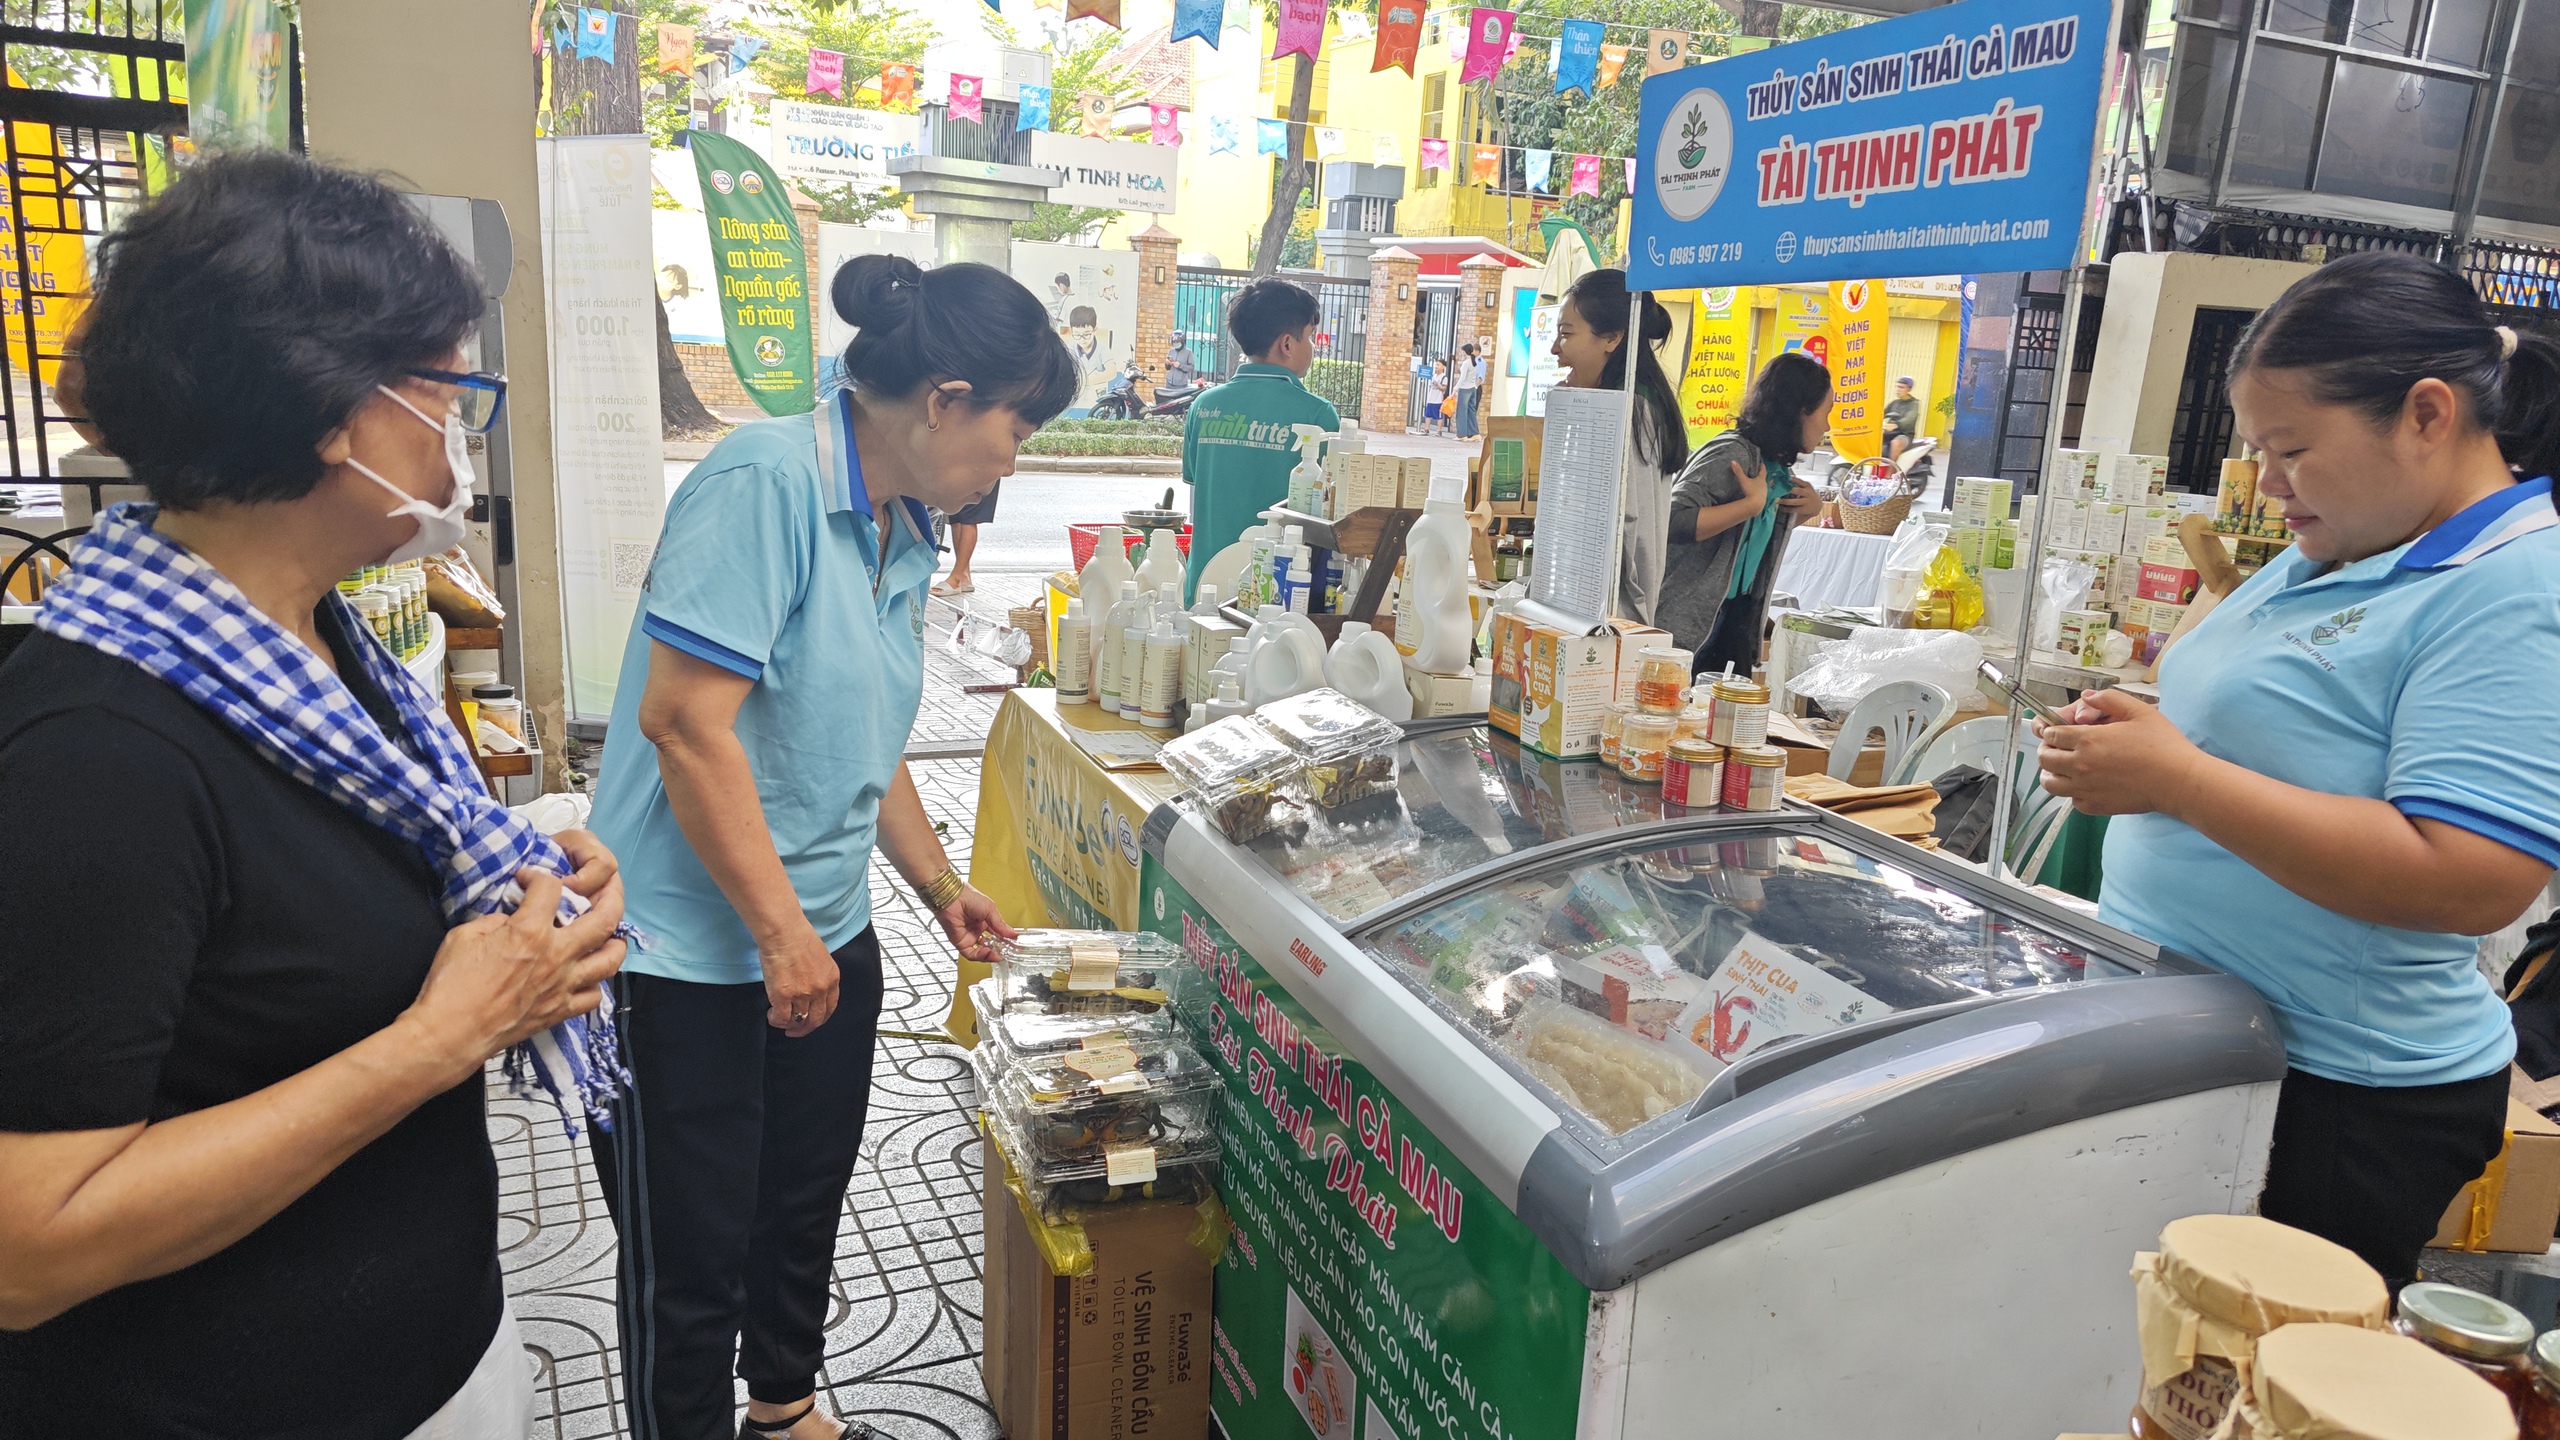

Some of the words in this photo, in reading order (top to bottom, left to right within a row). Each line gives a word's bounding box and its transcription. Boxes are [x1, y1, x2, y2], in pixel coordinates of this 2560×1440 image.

[1288, 7, 1321, 25] bạch
[1567, 26, 1590, 42] Thân
[1574, 40, 1598, 56] thiện
[1748, 70, 1795, 118] THỦY
[1801, 61, 1841, 107] SẢN
[1849, 57, 1902, 98] SINH
[1910, 40, 1960, 86] THÁI
[1970, 27, 2001, 75] CÀ
[2012, 19, 2076, 68] MAU
[786, 135, 874, 161] TRƯỜNG
[1760, 141, 1806, 201] TÀI
[1818, 131, 1921, 203] THỊNH
[1928, 104, 2037, 182] PHÁT
[1077, 167, 1121, 187] TINH
[1127, 172, 1166, 193] HOA
[1660, 171, 1681, 186] TÀI
[1681, 170, 1700, 184] THỊNH
[1700, 166, 1721, 181] PHÁT
[719, 216, 760, 245] Nông
[762, 217, 790, 241] sản
[1803, 218, 2049, 258] thuysansinhthaitaithinhphat.com
[727, 251, 748, 269] an
[1669, 246, 1696, 266] 0985
[1698, 244, 1719, 265] 997
[1721, 242, 1743, 263] 219
[724, 274, 774, 303] Nguồn
[775, 273, 801, 303] gốc
[737, 305, 756, 326] rõ
[757, 305, 795, 331] ràng
[1843, 320, 1870, 336] HÀNG
[1702, 332, 1732, 345] HÀNG
[1846, 336, 1866, 353] VIỆT
[1714, 366, 1740, 380] LƯỢNG
[1845, 355, 1865, 370] NAM
[1701, 384, 1725, 394] CAO
[1840, 369, 1867, 387] CHẤT
[1696, 395, 1730, 410] CHUẨN
[1833, 388, 1869, 405] LƯỢNG
[1689, 413, 1708, 429] HỘI
[1841, 406, 1865, 420] CAO
[1199, 415, 1249, 440] xanh
[1247, 420, 1270, 443] tử
[1268, 422, 1291, 445] tế
[1501, 662, 1514, 675] CUA
[1533, 660, 1552, 674] BÁNH
[1532, 681, 1551, 697] CUA
[1026, 817, 1059, 867] ENZYME
[1290, 937, 1325, 976] DARLING
[1725, 966, 1748, 986] SINH
[1746, 977, 1770, 998] THÁI
[1735, 950, 1769, 977] THỊT
[1766, 968, 1799, 995] CUA
[1182, 909, 1219, 982] THỦY
[1219, 948, 1252, 1023] SẢN
[1255, 989, 1298, 1072] SINH
[1302, 1035, 1352, 1128] THÁI
[1357, 1094, 1394, 1176] CÀ
[1401, 1134, 1463, 1244] MAU
[1208, 1001, 1242, 1074] Tài
[1248, 1047, 1316, 1160] Thịnh
[1323, 1133, 1398, 1251] Phát
[1219, 1118, 1247, 1169] NHIÊN
[1248, 1155, 1269, 1196] MỖI
[1269, 1184, 1308, 1246] THÁNG
[1309, 1235, 1317, 1256] 2
[1319, 1246, 1345, 1296] LẦN
[1348, 1281, 1376, 1332] VÀO
[1378, 1325, 1410, 1380] CON
[1224, 1086, 1253, 1135] NHIÊN
[1255, 1122, 1292, 1182] TRONG
[1294, 1173, 1328, 1227] RỪNG
[1330, 1217, 1367, 1269] NGẬP
[1369, 1260, 1400, 1317] MẶN
[1403, 1303, 1438, 1363] NĂM
[1441, 1353, 1476, 1411] CĂN
[1130, 1271, 1156, 1298] VỆ
[1113, 1276, 1126, 1327] TOILET
[1222, 1160, 1236, 1191] TỪ
[1236, 1181, 1276, 1250] NGUYÊN
[1278, 1237, 1302, 1284] LIỆU
[1304, 1271, 1331, 1321] ĐẾN
[1333, 1308, 1377, 1388] THÀNH
[1379, 1376, 1421, 1440] PHẨM
[1133, 1301, 1152, 1347] SINH
[1168, 1314, 1176, 1346] ENZYME
[1111, 1333, 1125, 1374] BOWL
[1132, 1351, 1156, 1392] BỒN
[1167, 1350, 1175, 1386] CLEANER
[1057, 1383, 1066, 1432] nhiên
[1110, 1378, 1124, 1440] CLEANER
[1130, 1396, 1155, 1436] CẦU
